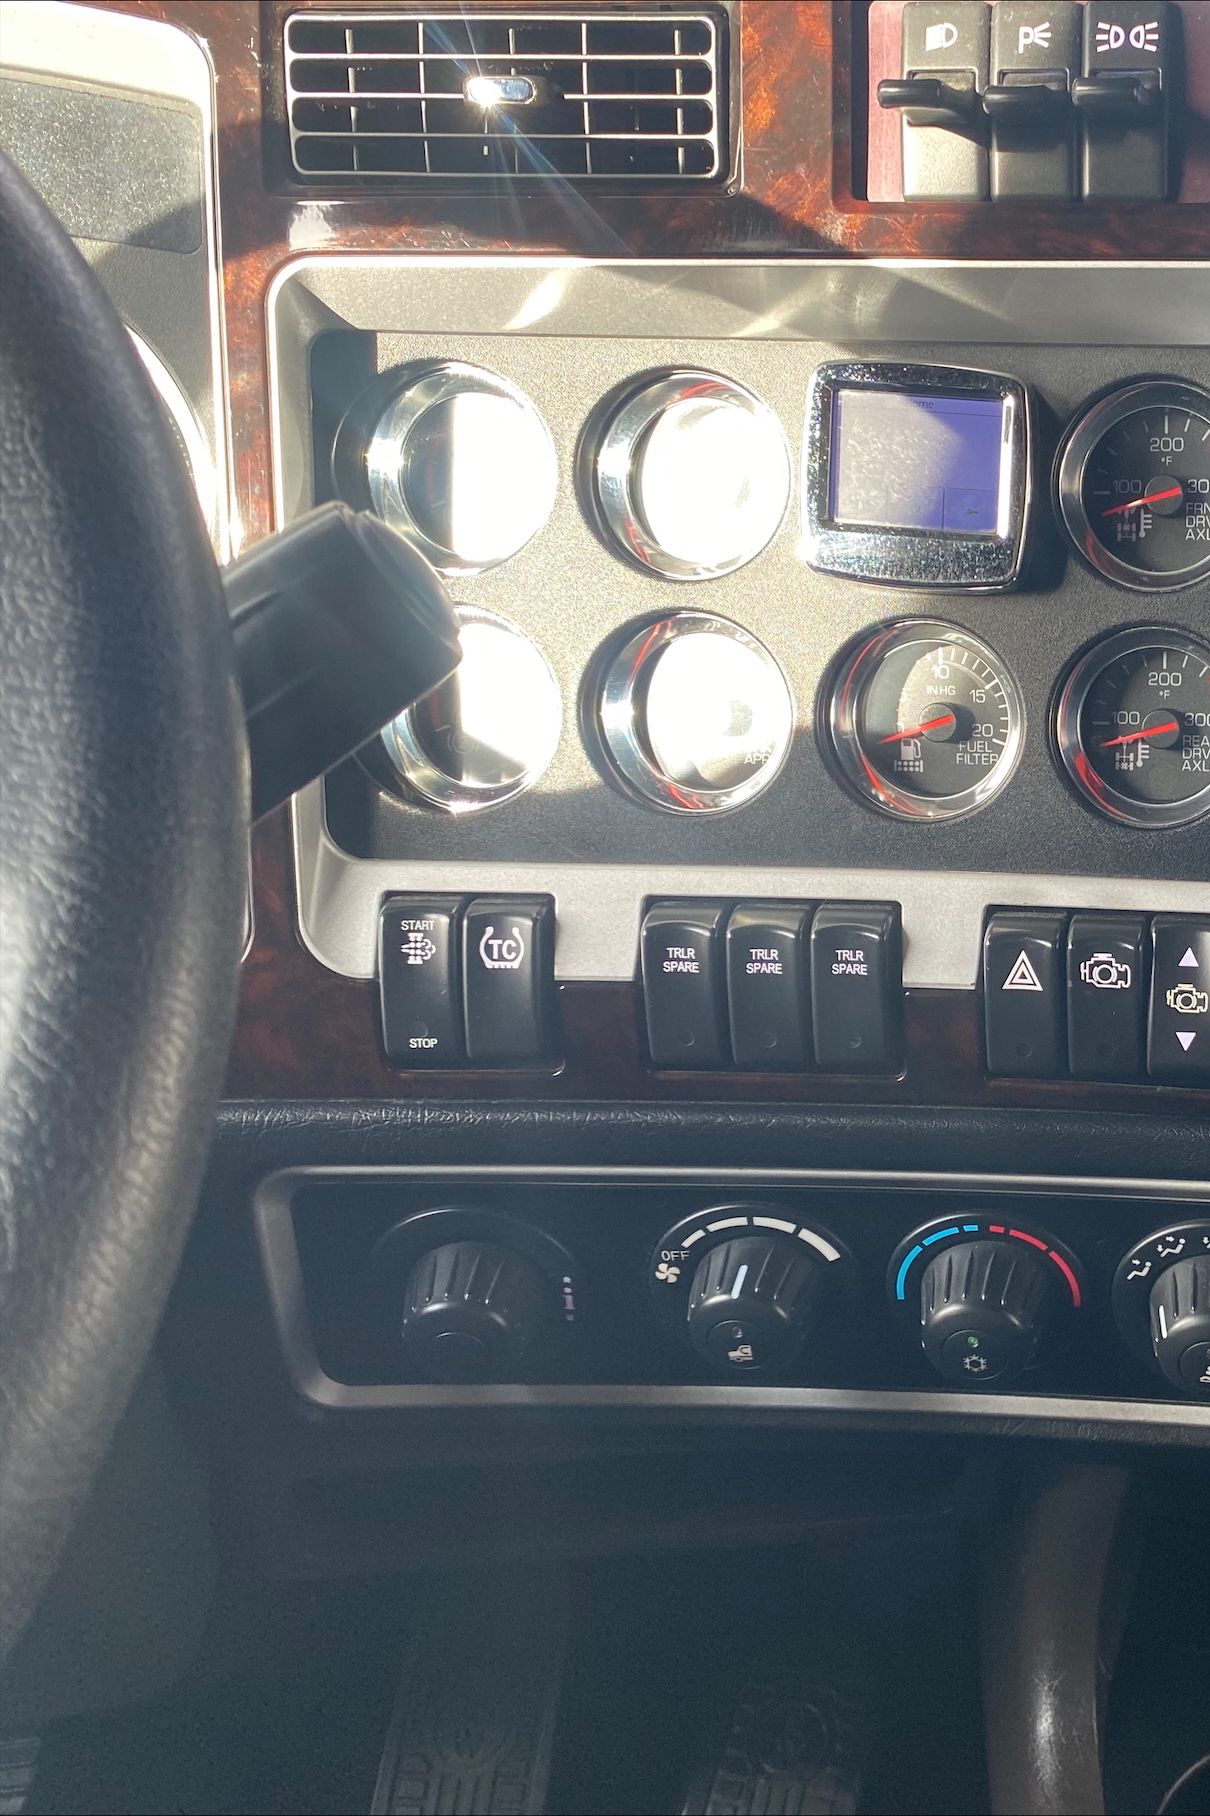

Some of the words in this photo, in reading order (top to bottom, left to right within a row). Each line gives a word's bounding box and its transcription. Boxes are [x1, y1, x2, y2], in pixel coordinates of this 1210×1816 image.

[1150, 437, 1184, 452] 200
[1112, 479, 1142, 494] 100
[930, 665, 950, 679] 10
[1148, 672, 1182, 687] 200
[969, 689, 986, 703] 15
[1111, 711, 1140, 725] 100
[971, 724, 994, 738] 20
[957, 740, 993, 753] FUEL
[956, 753, 999, 766] FILTER
[401, 920, 435, 931] START
[488, 939, 518, 962] TC
[666, 947, 695, 960] TRLR
[750, 948, 778, 961] TRLR
[836, 949, 864, 962] TRLR
[663, 961, 699, 974] SPARE
[746, 962, 782, 975] SPARE
[831, 962, 868, 976] SPARE
[409, 1038, 438, 1049] STOP
[661, 1250, 690, 1262] OFF
